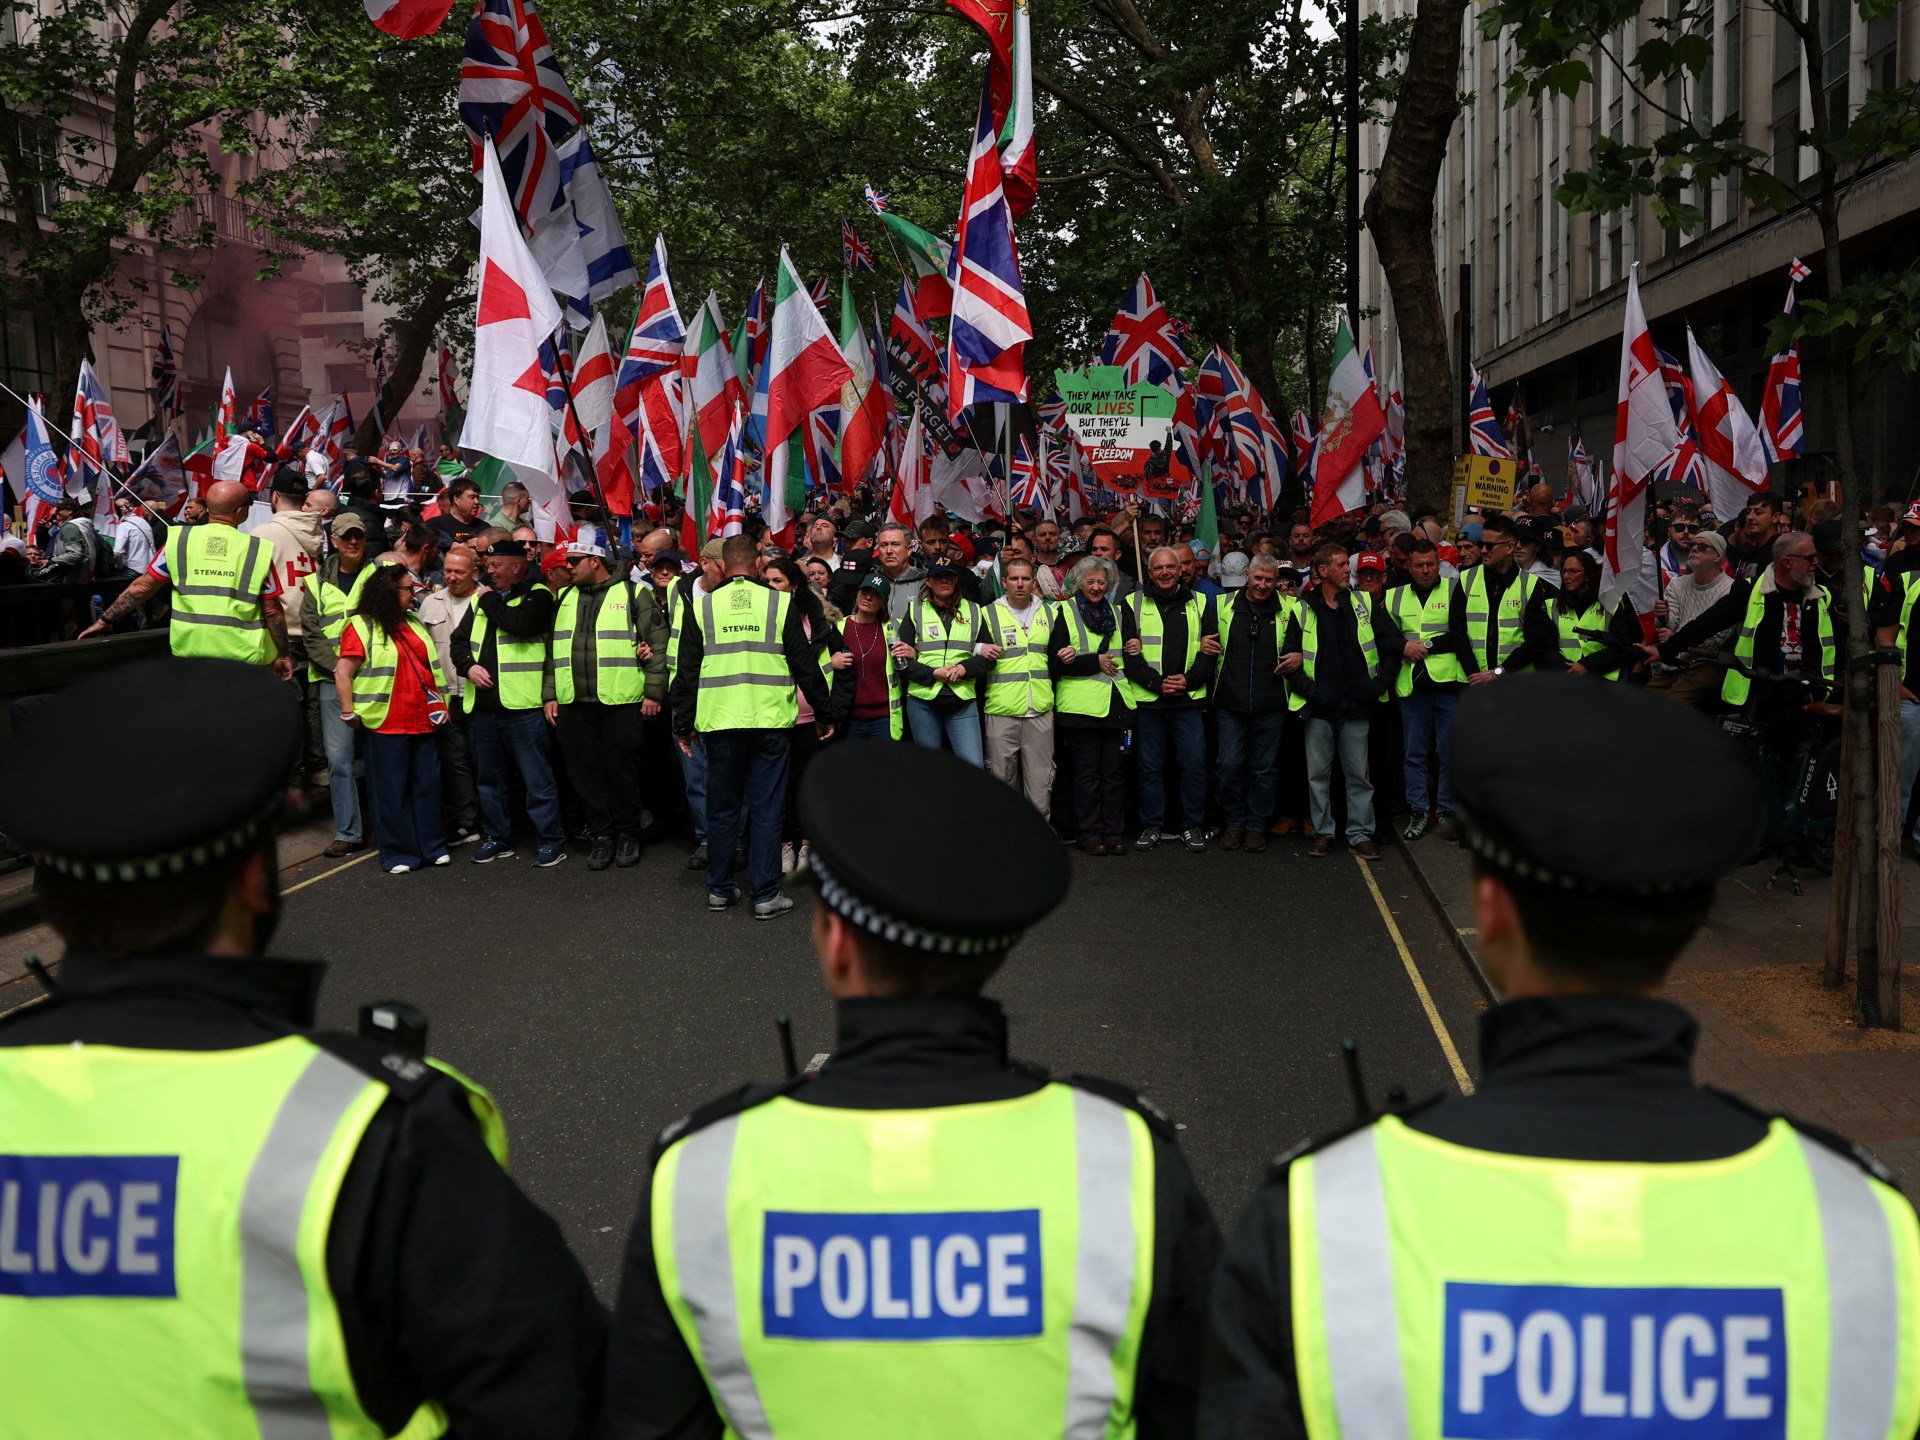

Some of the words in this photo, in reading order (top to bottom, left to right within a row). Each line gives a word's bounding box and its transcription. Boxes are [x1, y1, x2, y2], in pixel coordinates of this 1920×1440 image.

[1066, 390, 1089, 401] THEY
[1092, 391, 1111, 400] MAY
[1114, 390, 1137, 400] TAKE
[889, 371, 907, 393] WE
[905, 390, 954, 442] FORGET
[1070, 402, 1092, 414] OUR
[1096, 402, 1135, 415] LIVES
[1079, 418, 1096, 427] BUT
[1099, 417, 1130, 427] THEY'LL
[1082, 429, 1107, 438] NEVER
[1108, 428, 1128, 438] TAKE
[1100, 439, 1116, 448] OUR
[1092, 447, 1134, 460] FREEDOM
[1475, 482, 1509, 494] WARNING
[1482, 492, 1501, 500] Parking
[935, 557, 951, 566] 47
[193, 568, 235, 577] STEWARD
[1800, 758, 1817, 803] forest
[773, 1233, 1030, 1320] POLICE
[1458, 1310, 1773, 1421] POLICE
